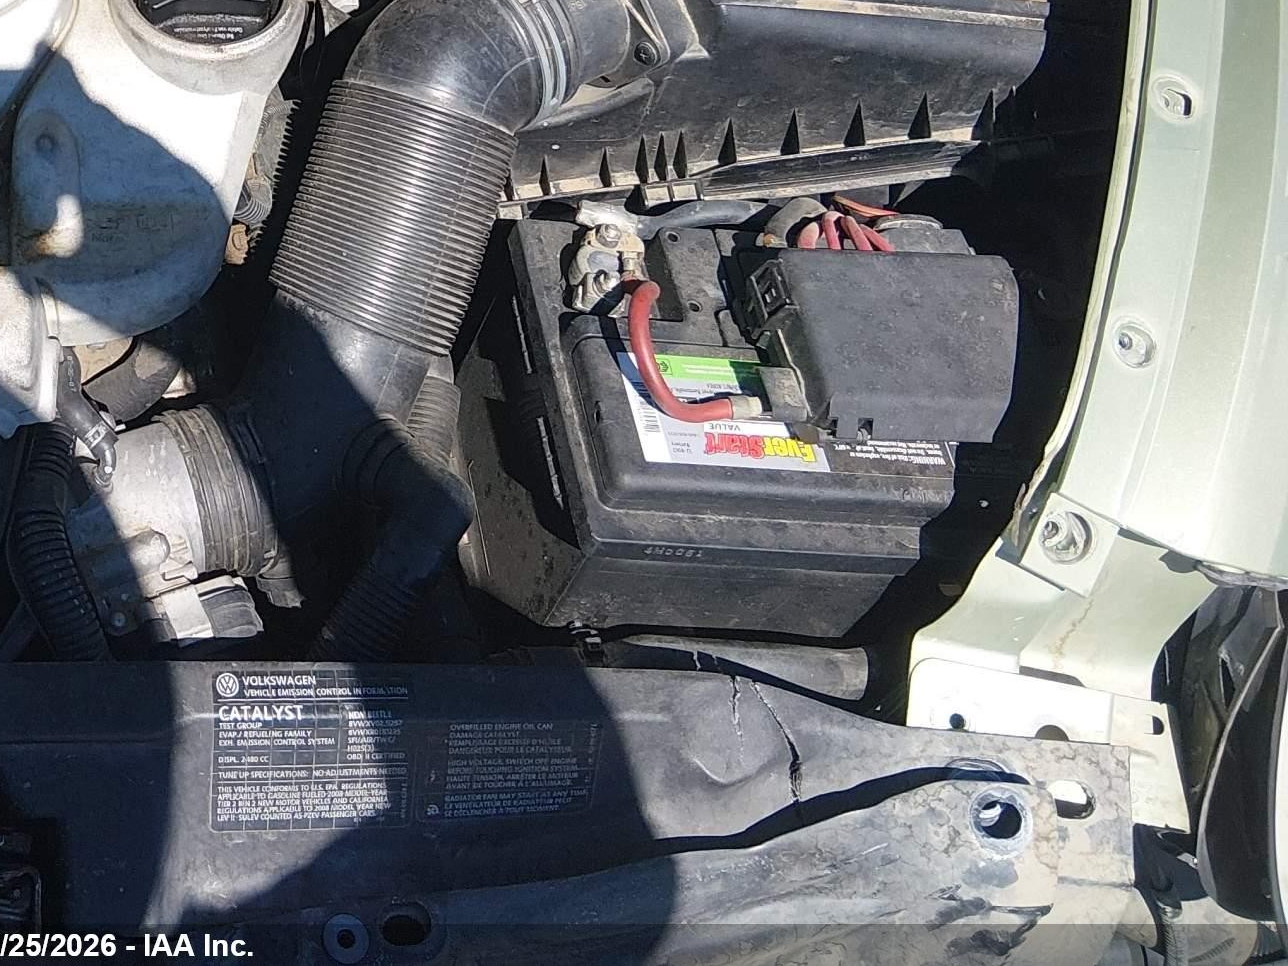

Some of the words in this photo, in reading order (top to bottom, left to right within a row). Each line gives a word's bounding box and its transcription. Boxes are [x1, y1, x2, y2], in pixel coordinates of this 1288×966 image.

[708, 423, 741, 432] VALUE
[704, 433, 816, 462] EverStart
[242, 675, 317, 687] VOLKSWAGEN
[244, 689, 276, 698] VEHICLE
[277, 688, 314, 697] EMISSION
[316, 687, 352, 696] CONTROL
[353, 686, 409, 695] INFORMATION
[218, 705, 304, 722] CATALYST
[218, 722, 235, 730] TEST
[449, 723, 493, 731] OVERFILLED
[494, 723, 521, 731] ENGINE
[537, 722, 554, 730] CAN
[243, 730, 282, 738] REFUELING
[236, 738, 271, 746] EMISSION
[273, 738, 306, 746] CONTROL
[307, 737, 336, 745] SYSTEM
[218, 756, 239, 764] DISPL.
[346, 753, 362, 761] OBD
[371, 752, 406, 760] CERTIFIED
[550, 757, 578, 765] ENGINE
[218, 770, 238, 779] TUNE
[239, 770, 250, 778] UP
[313, 769, 325, 777] NO
[326, 768, 378, 777] ADJUSTMENTS
[379, 767, 408, 776] NEEDED
[447, 766, 473, 774] BEFORE
[234, 785, 261, 793] VEHICLE
[301, 784, 310, 792] TO
[340, 782, 388, 790] REGULATIONS
[217, 793, 256, 801] APPLICABLE
[268, 792, 301, 800] GASOLINE
[302, 791, 327, 799] FUELED
[345, 790, 369, 798] MODEL
[371, 789, 388, 797] YEAR
[444, 794, 482, 802] RADIATOR
[217, 800, 231, 808] TIER
[301, 798, 331, 806] VEHICLES
[349, 796, 389, 804] CALIFORNIA
[217, 807, 262, 815] REGULATIONS
[263, 806, 302, 814] APPLICABLE
[238, 814, 260, 822] SULEV
[261, 813, 292, 821] COUNTED
[320, 811, 358, 819] PASSENGER
